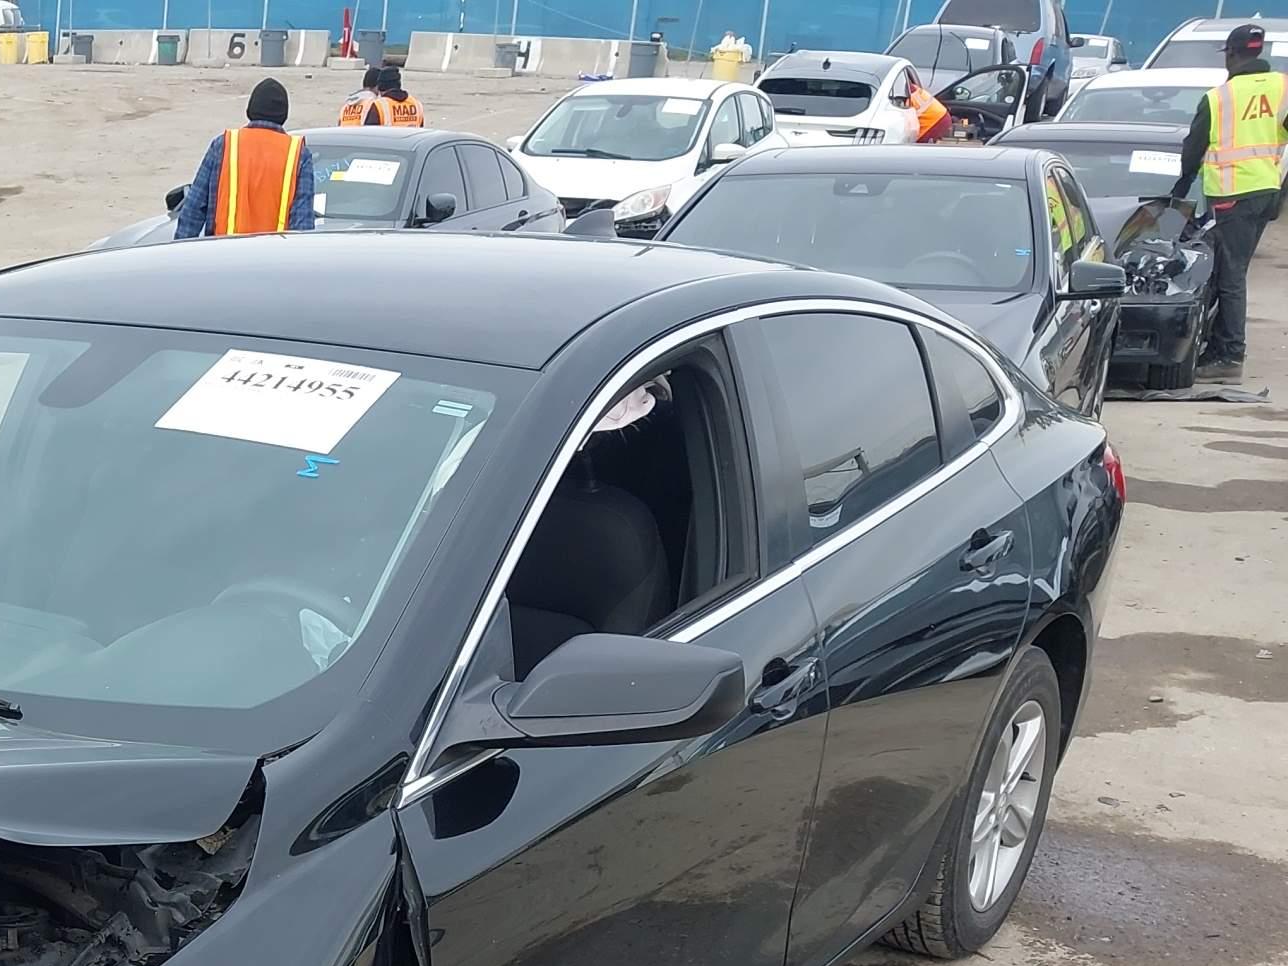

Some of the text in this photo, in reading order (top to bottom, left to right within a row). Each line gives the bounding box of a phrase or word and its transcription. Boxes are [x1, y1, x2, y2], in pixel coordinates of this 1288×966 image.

[227, 32, 246, 59] 6
[343, 104, 364, 116] MAD
[392, 104, 417, 116] MAD
[220, 369, 361, 401] 44214955
